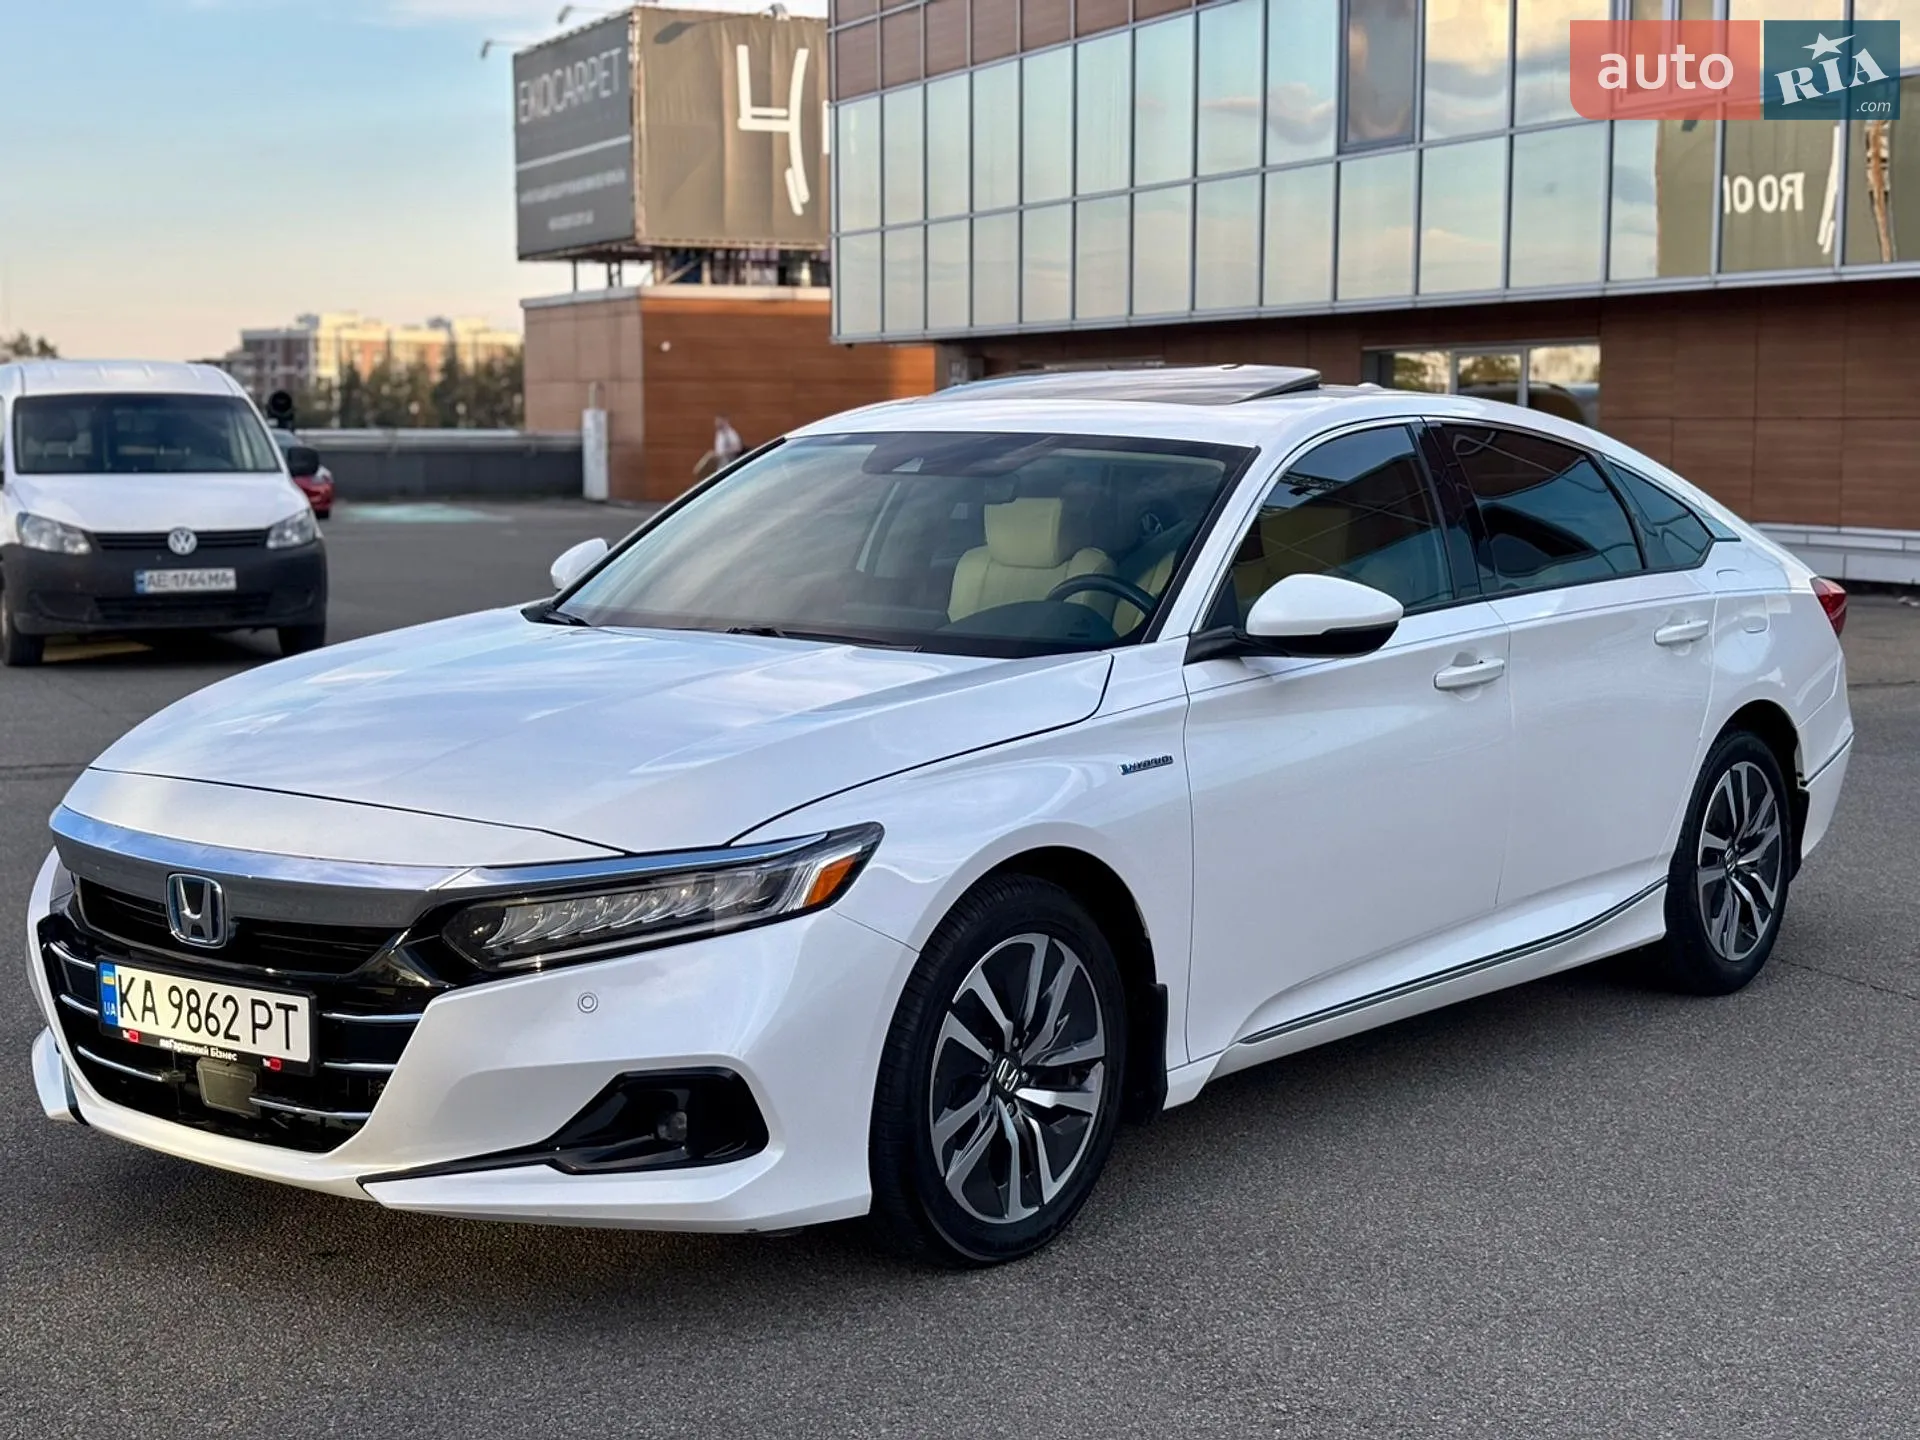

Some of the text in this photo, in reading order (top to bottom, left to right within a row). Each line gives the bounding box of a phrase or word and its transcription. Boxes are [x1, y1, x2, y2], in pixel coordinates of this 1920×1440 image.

[103, 1001, 116, 1017] UA
[117, 974, 298, 1050] KA 9862 PT
